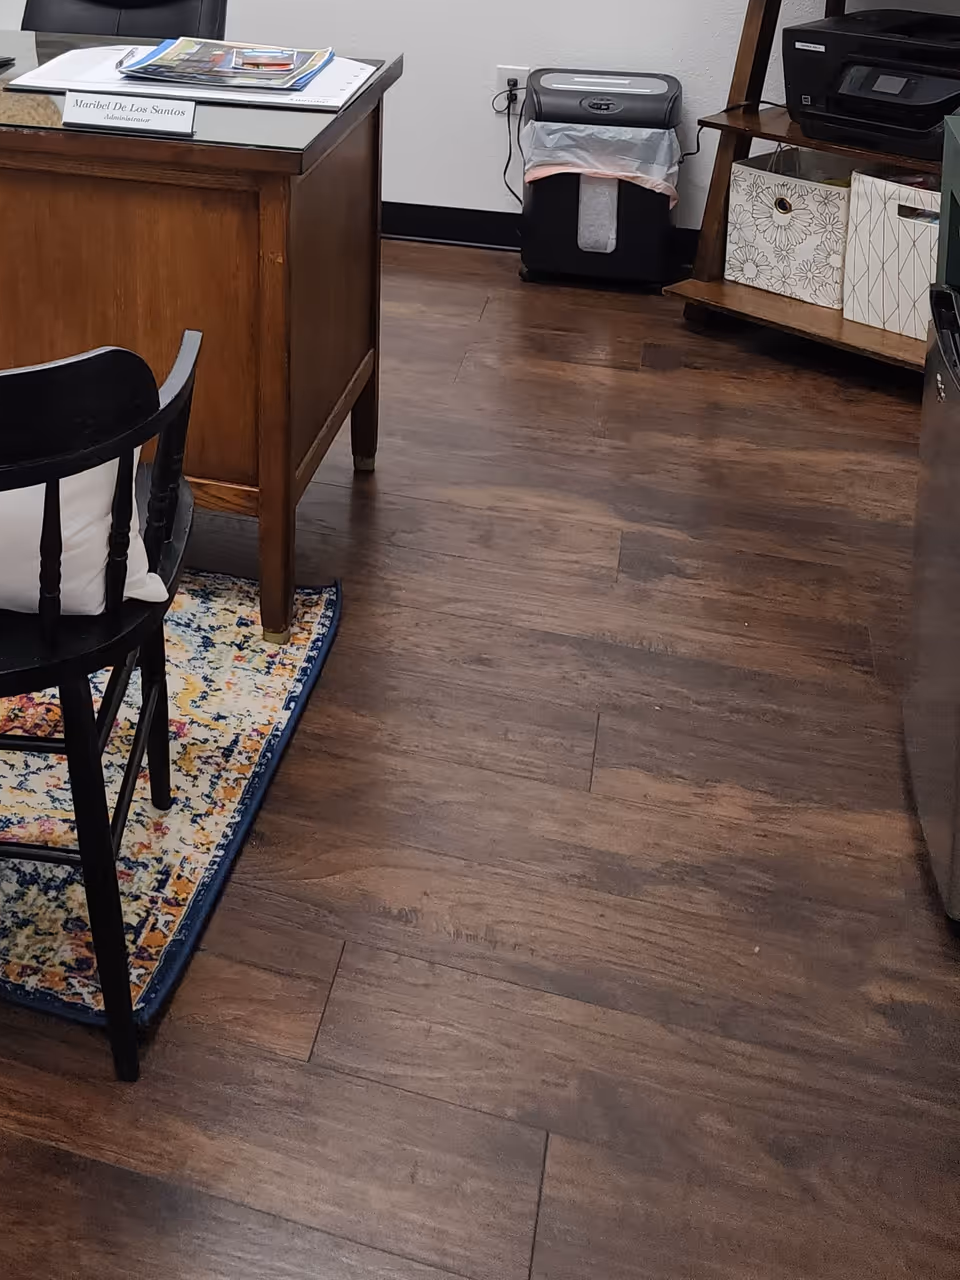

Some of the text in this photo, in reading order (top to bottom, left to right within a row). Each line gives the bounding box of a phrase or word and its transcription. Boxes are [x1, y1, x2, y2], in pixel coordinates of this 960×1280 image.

[73, 98, 186, 117] Maribel De Los Santos
[103, 113, 151, 123] Administrator
